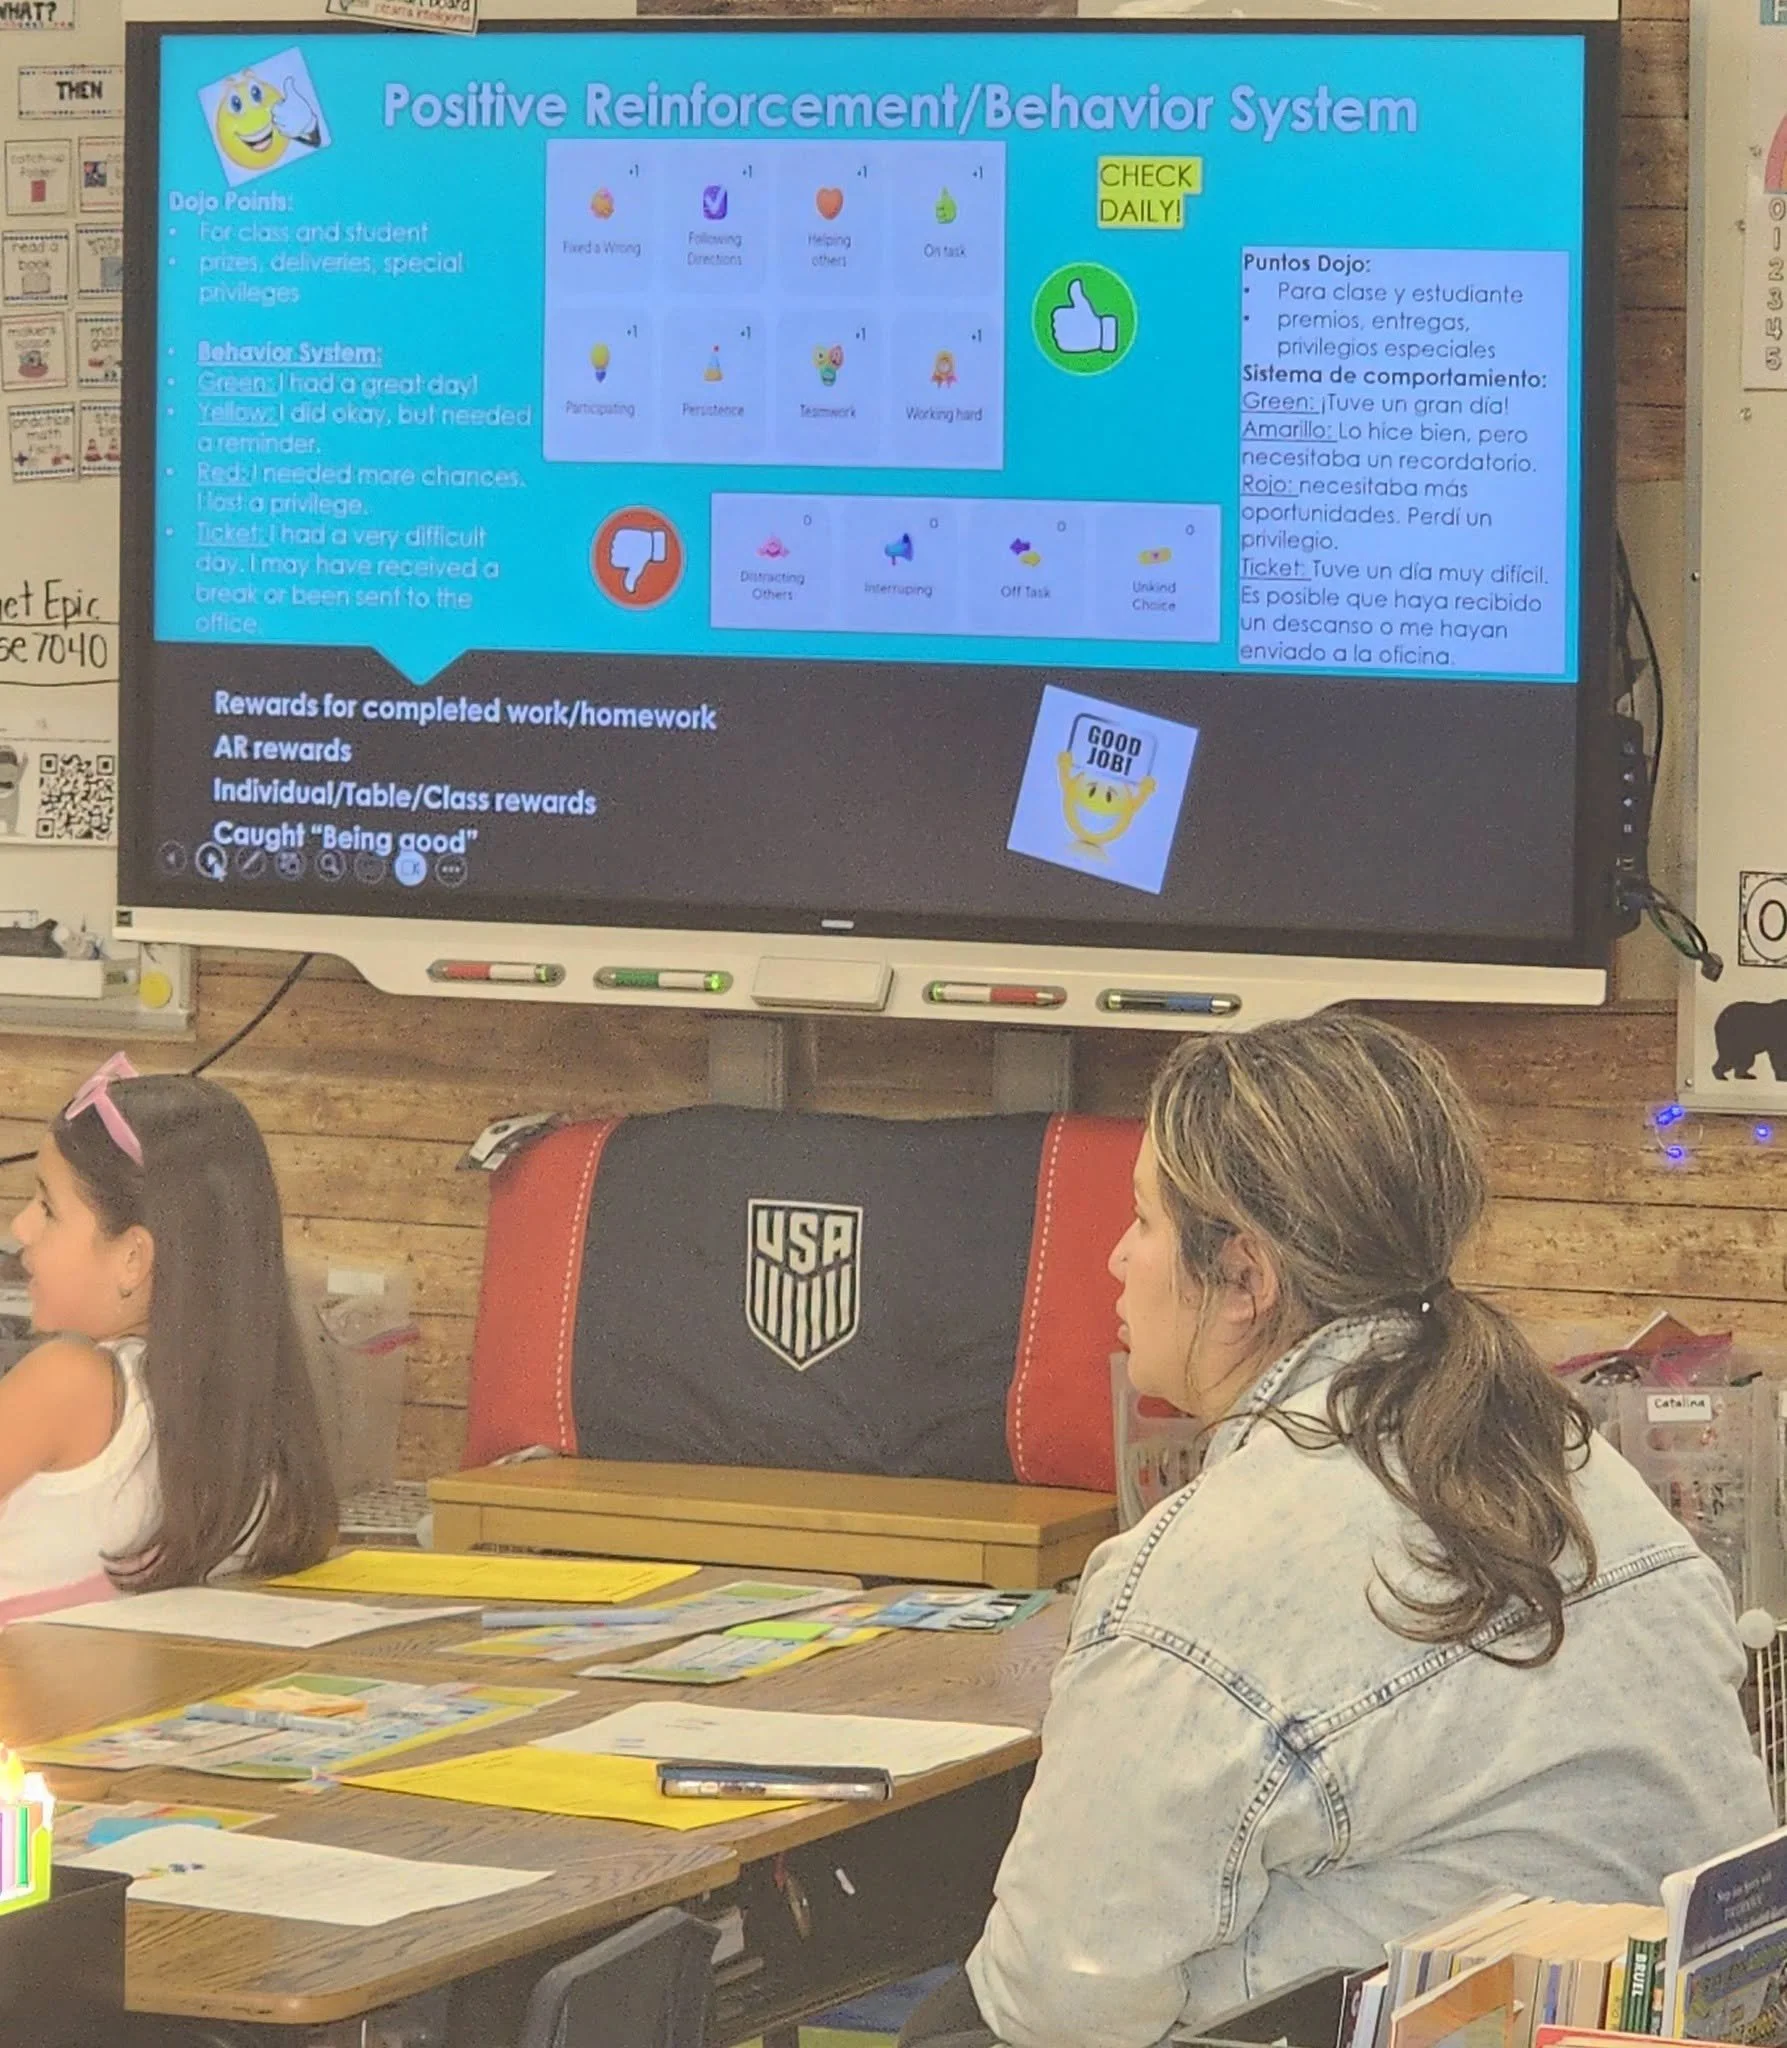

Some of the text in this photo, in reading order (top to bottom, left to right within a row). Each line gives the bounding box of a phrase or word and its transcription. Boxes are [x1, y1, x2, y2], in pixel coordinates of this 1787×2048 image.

[56, 81, 103, 101] THEN
[383, 81, 1418, 143] Positive Reinforcement/Behavior System
[1100, 163, 1193, 187] CHECK
[169, 191, 294, 214] Dojo Points:
[1100, 197, 1182, 223] DAILY!
[1769, 199, 1786, 221] 0
[200, 221, 428, 241] For class and student
[688, 231, 742, 248] Following
[808, 232, 852, 249] Helping
[1773, 227, 1780, 251] 1
[562, 239, 641, 257] Fixed Wrong
[687, 252, 743, 266] Directions
[811, 252, 847, 267] others
[923, 242, 967, 258] On task
[200, 252, 464, 278] prizes, deliveries, special
[1243, 253, 1372, 275] Puntos Dojo:
[1768, 259, 1784, 281] 2
[200, 283, 300, 306] privileges
[1278, 281, 1524, 304] Para clase y estudiante
[1767, 287, 1783, 310] 3
[1278, 309, 1470, 334] premios, entregas,
[1765, 317, 1783, 341] 4
[198, 341, 383, 364] Behavior System:
[1278, 337, 1496, 359] privilegios especiales
[1765, 348, 1782, 370] 5
[199, 371, 479, 396] Green: had great day!
[1243, 363, 1548, 389] Sistema de comportamiento:
[199, 401, 532, 426] Yellow: did okay, but needed
[565, 401, 635, 418] Participating
[682, 402, 744, 417] Persistence
[800, 403, 856, 419] Teamwork
[906, 406, 983, 423] Working hard
[1243, 390, 1509, 416] Green: ¡Tuve un gran día!
[217, 432, 321, 452] reminder.
[1242, 419, 1528, 444] Amarillo: Lo hice bien, pero
[1242, 447, 1538, 472] necesitaba un recordatorio.
[197, 461, 527, 486] Red: needed more chances.
[1242, 473, 1469, 497] Rojo: necesitaba más
[205, 491, 369, 517] lost privilege.
[1242, 503, 1493, 526] oportunidades. Perdí un
[197, 521, 486, 549] Ticket: had very difficult
[1241, 530, 1339, 551] privilegio.
[196, 552, 478, 577] day. may have received
[1241, 557, 1549, 584] Ticket: Tuve un día muy difícil.
[740, 569, 805, 585] Distracting
[1132, 579, 1177, 594] Unkind
[196, 581, 472, 608] break or been sent to the
[752, 586, 793, 600] Others
[1001, 584, 1051, 599] Off Task
[1241, 585, 1542, 612] Es posible que haya recibido
[45, 579, 100, 630] Epic
[1132, 597, 1176, 612] Choice
[196, 611, 263, 633] office.
[1241, 614, 1508, 639] un descanso o me hayan
[1240, 640, 1455, 665] enviado a la oficina.
[215, 691, 717, 730] Rewards for completed work/homework
[215, 735, 352, 763] AR rewards
[1088, 726, 1142, 757] GOOD
[1087, 748, 1132, 776] JOB!
[213, 778, 596, 814] Individual/Table/Class rewards
[213, 821, 305, 853] Caught
[757, 1209, 853, 1275] USA
[1655, 1397, 1706, 1409] Catalina
